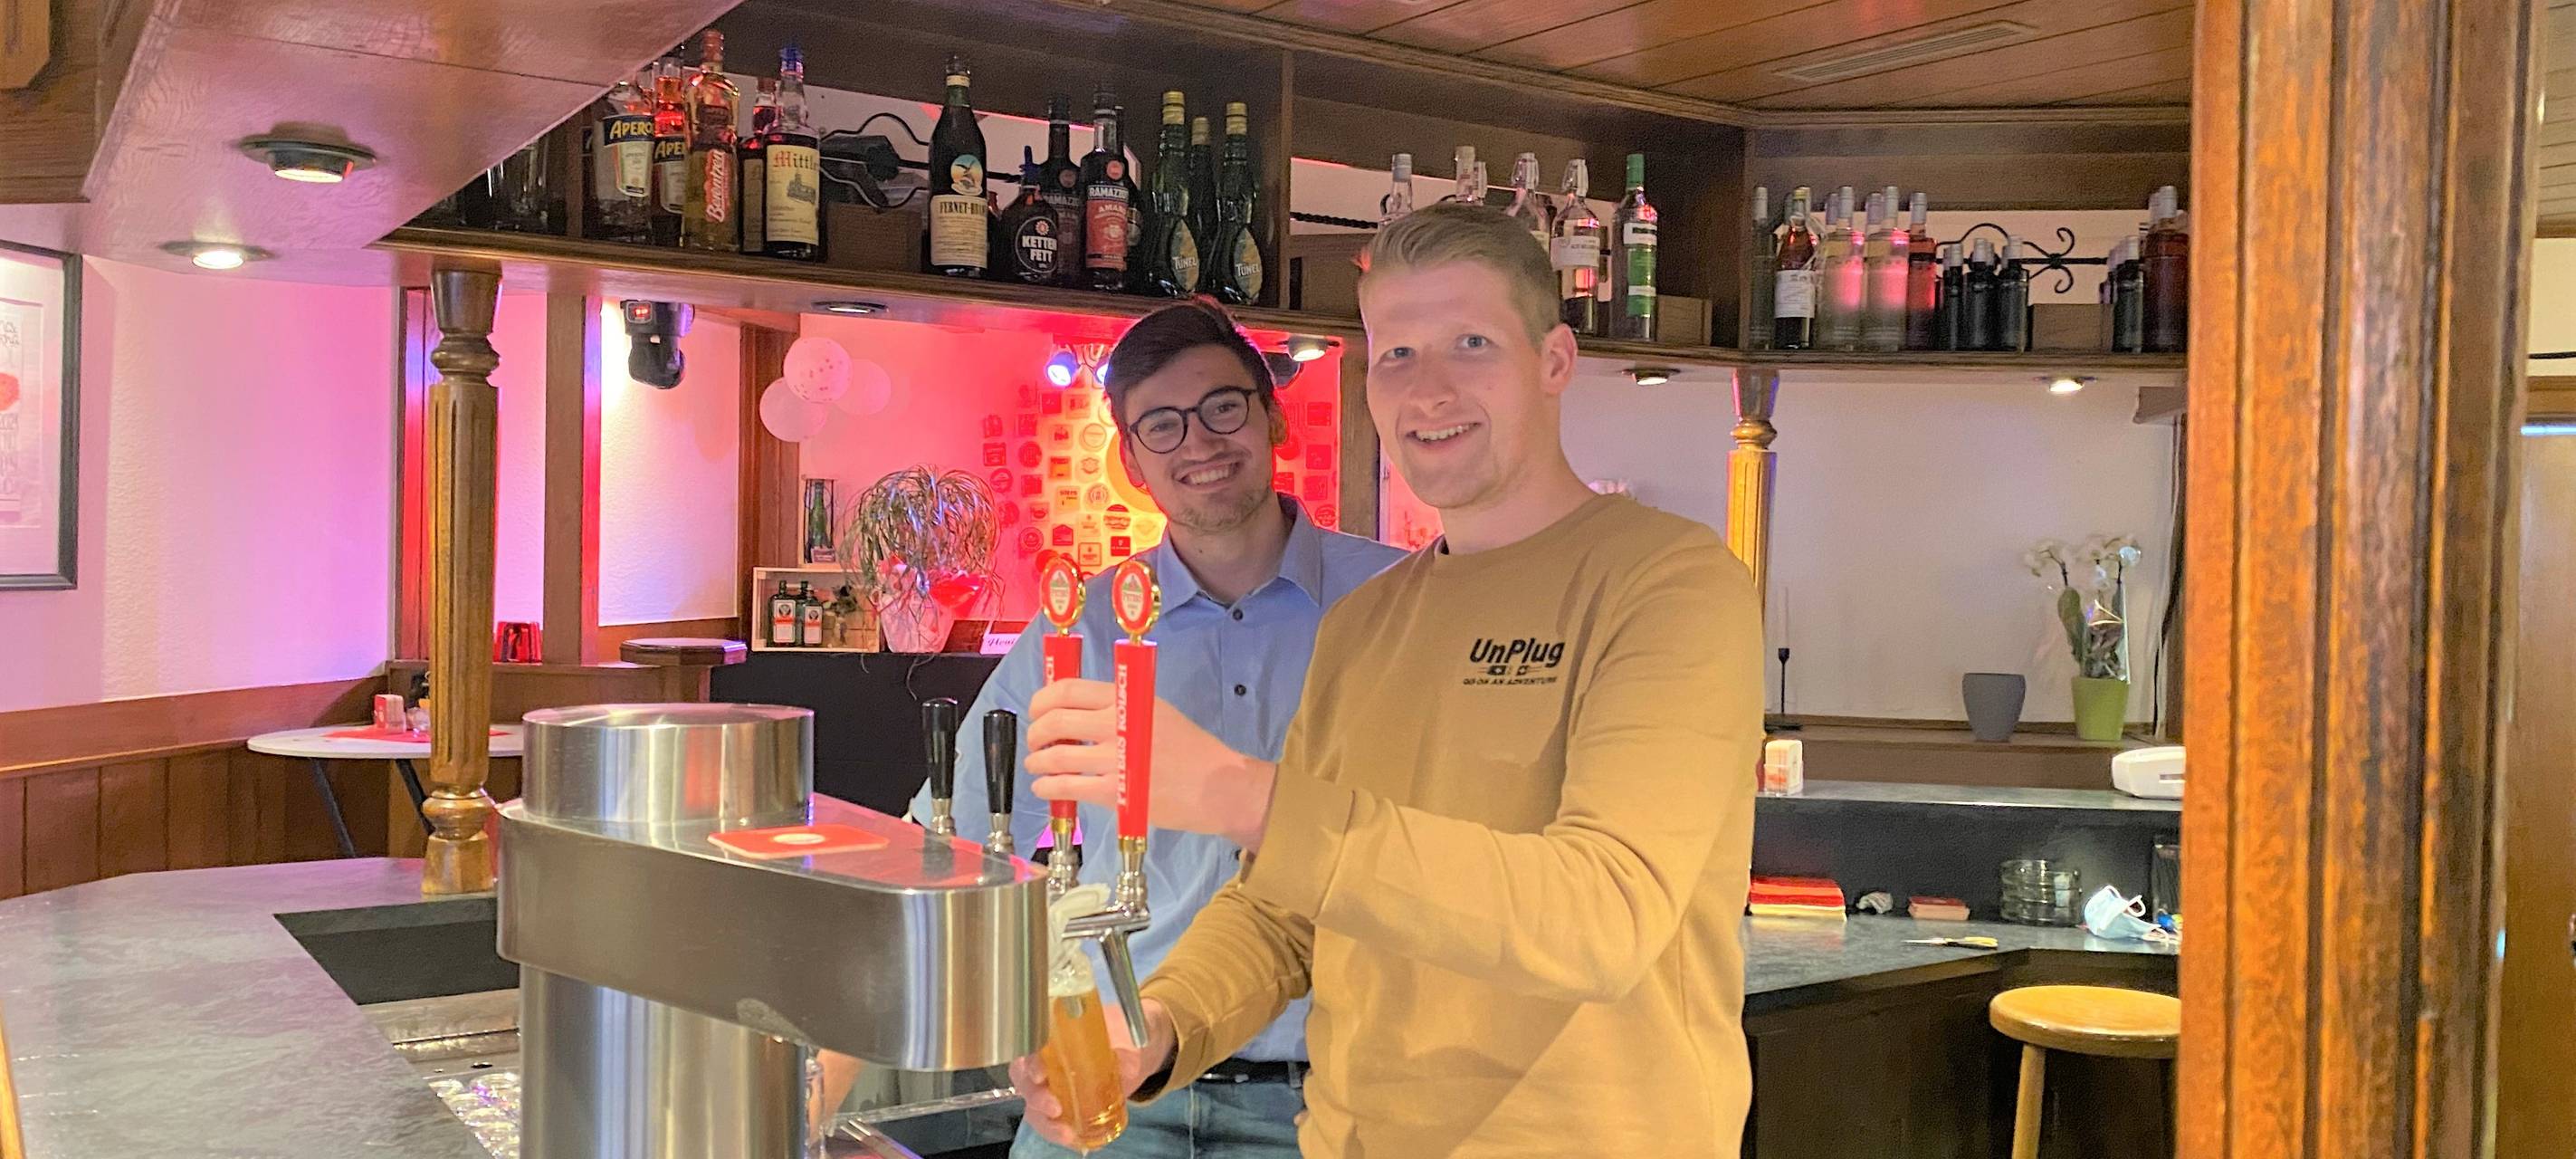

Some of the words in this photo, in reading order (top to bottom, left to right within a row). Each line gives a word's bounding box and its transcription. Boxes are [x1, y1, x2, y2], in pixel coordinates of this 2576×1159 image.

[654, 140, 685, 159] APE
[1030, 249, 1053, 263] FETT
[1469, 637, 1566, 668] UnPlug
